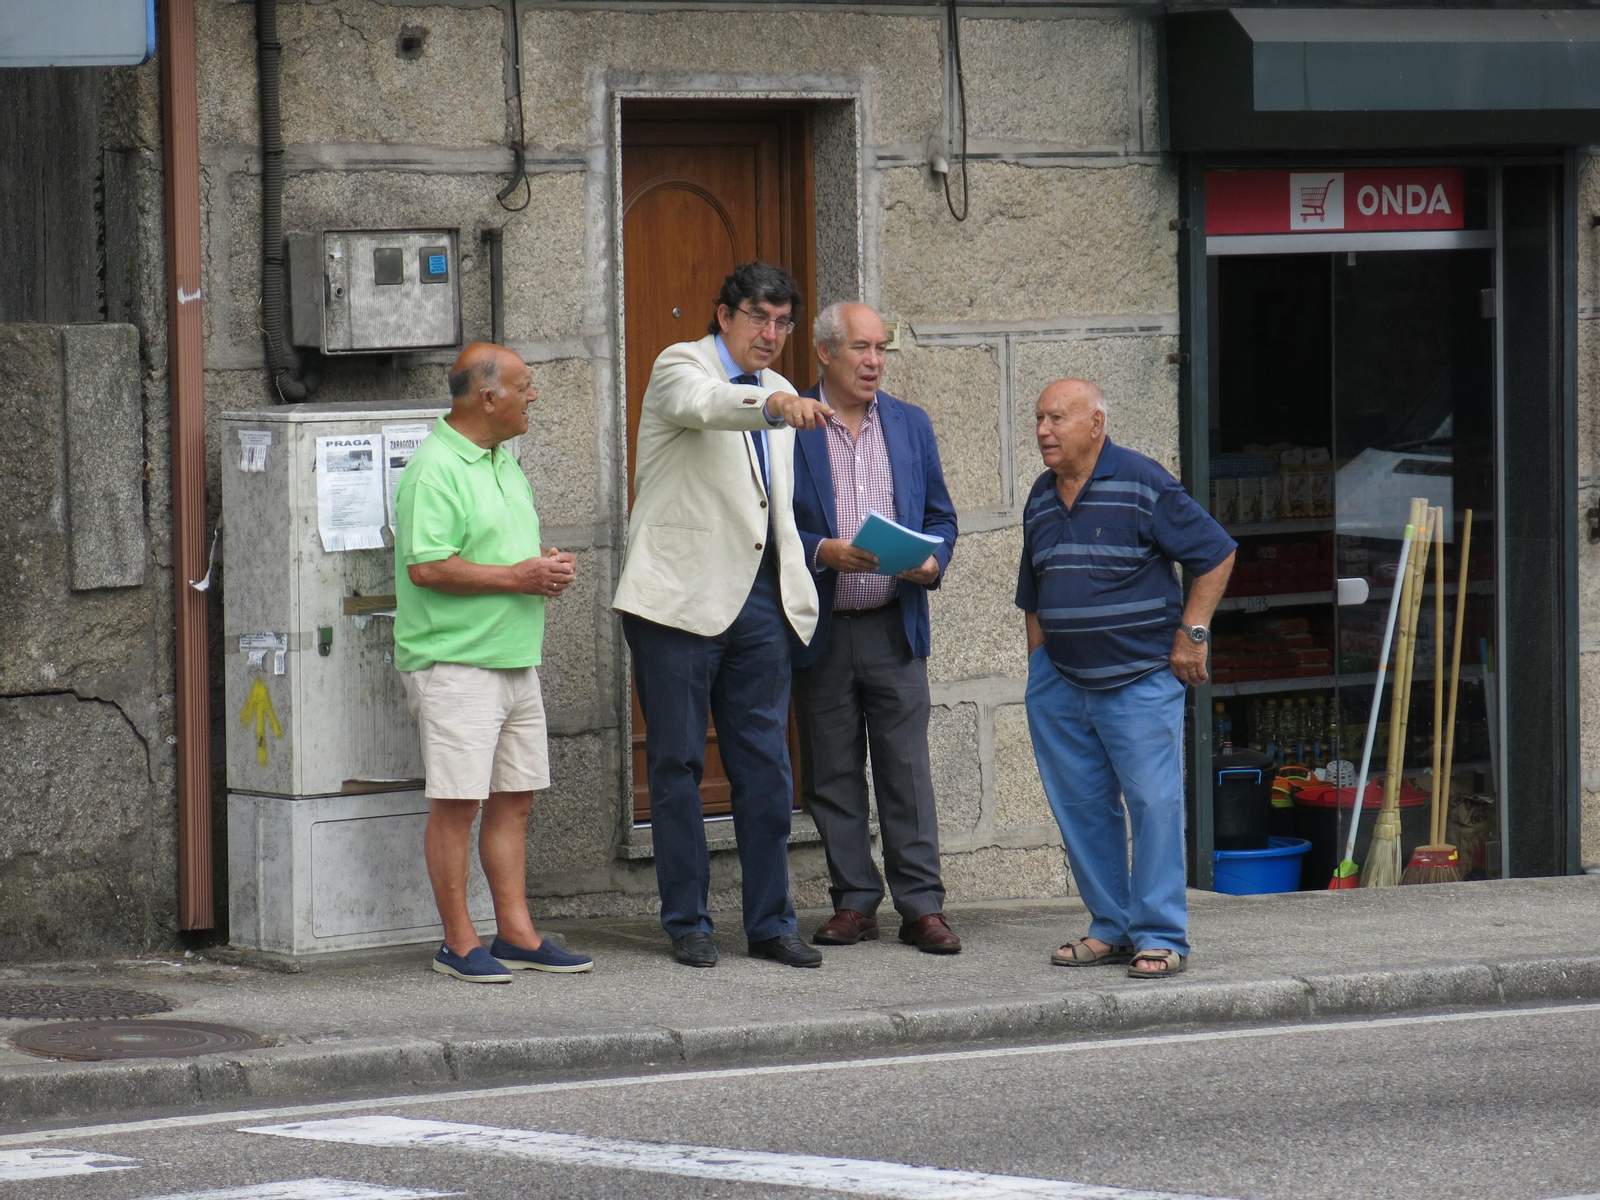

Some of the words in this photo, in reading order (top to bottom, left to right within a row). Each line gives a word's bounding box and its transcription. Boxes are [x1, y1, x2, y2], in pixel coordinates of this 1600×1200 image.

[1357, 183, 1452, 216] ONDA
[326, 439, 371, 448] PRAGA
[390, 439, 415, 450] ZARAGOZA
